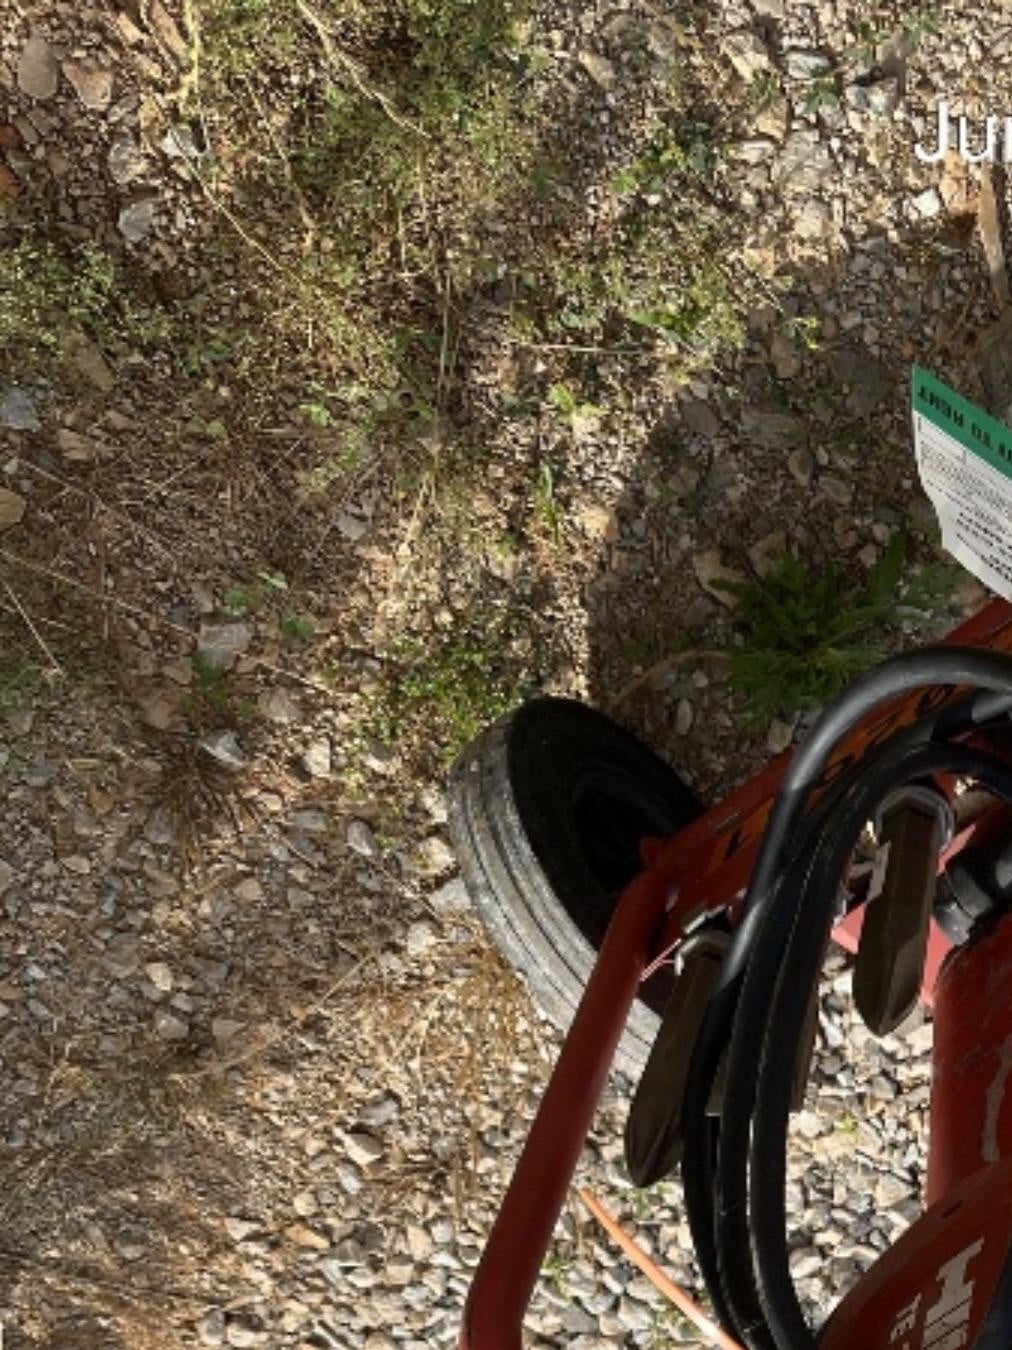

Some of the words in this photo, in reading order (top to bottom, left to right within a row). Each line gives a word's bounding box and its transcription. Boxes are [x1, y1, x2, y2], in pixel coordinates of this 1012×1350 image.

[917, 385, 964, 428] RENT
[971, 422, 994, 450] TO
[890, 1292, 922, 1342] TE
